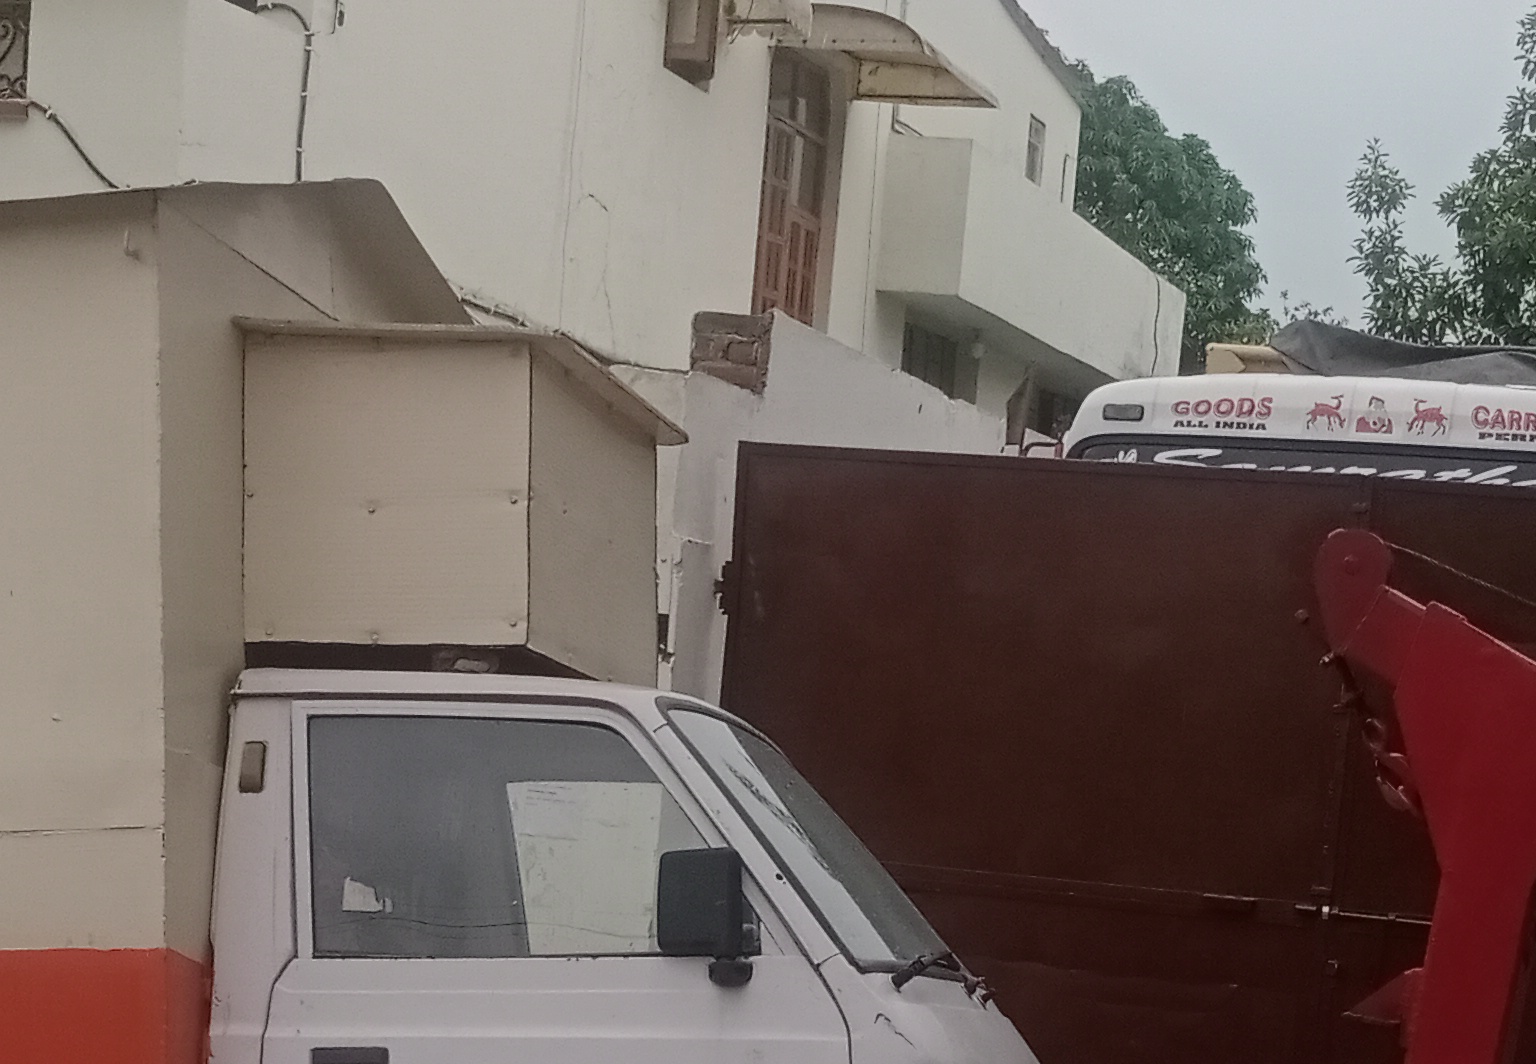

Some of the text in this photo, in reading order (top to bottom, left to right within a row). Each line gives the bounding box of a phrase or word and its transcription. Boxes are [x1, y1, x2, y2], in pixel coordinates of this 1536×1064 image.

[1170, 396, 1274, 420] GOODS
[1173, 419, 1267, 431] ALL INDIA
